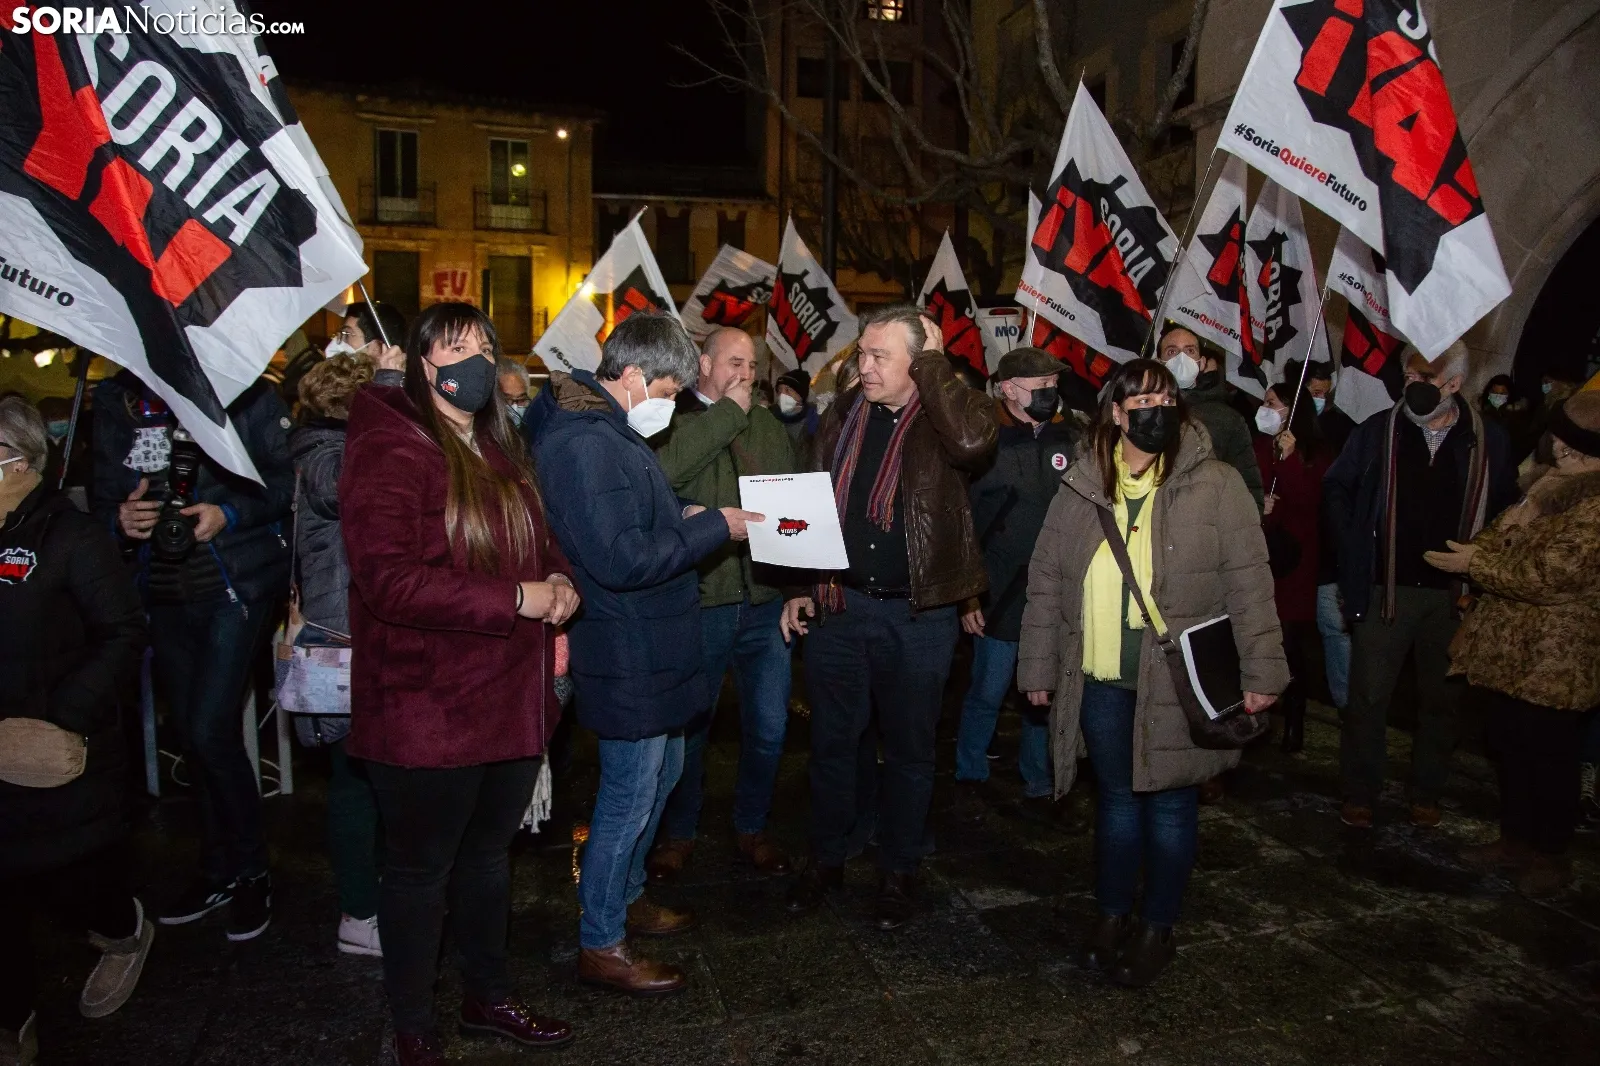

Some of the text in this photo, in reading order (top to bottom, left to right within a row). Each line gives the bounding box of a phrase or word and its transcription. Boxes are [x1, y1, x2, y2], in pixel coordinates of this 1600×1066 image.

[1233, 122, 1368, 212] #SoriaQuiereFuturo
[788, 282, 828, 340] SORIA
[4, 555, 30, 566] SORIA
